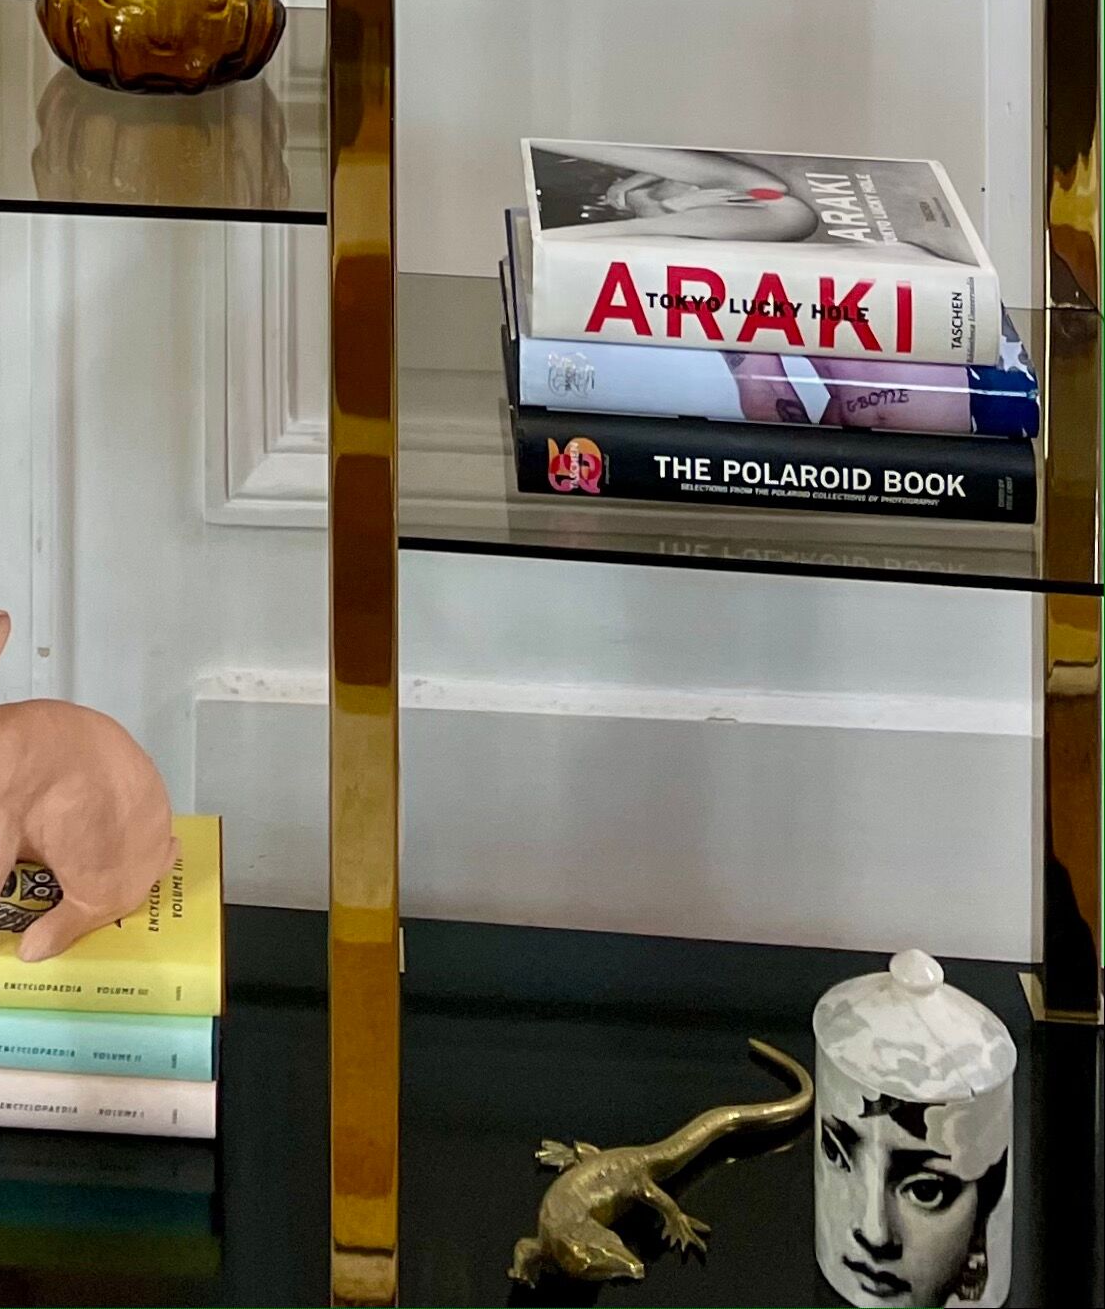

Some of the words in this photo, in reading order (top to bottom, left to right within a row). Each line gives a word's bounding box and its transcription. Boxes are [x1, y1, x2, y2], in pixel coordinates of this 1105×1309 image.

[855, 173, 877, 194] HOLE
[805, 172, 877, 244] ARAKI
[864, 193, 888, 220] LUCKY
[584, 261, 913, 353] ARAKI
[645, 292, 721, 313] TOKYO
[729, 298, 803, 319] LUCKY
[811, 303, 870, 323] HOLE
[951, 291, 963, 349] TASCHEN
[653, 455, 711, 481] THE
[723, 459, 872, 491] POLAROID
[883, 469, 966, 497] BOOK
[680, 483, 728, 493] SELECTIONS
[729, 486, 753, 494] FROM
[755, 487, 769, 496] THE
[771, 488, 810, 498] POLAROID
[812, 491, 866, 502] COLLECTIONS
[881, 496, 940, 506] PHOTOGRAPHY
[148, 880, 161, 931] ENCYCLO
[172, 875, 183, 918] VOLUME
[4, 982, 82, 993] ENCYCLOPAEDIA
[97, 986, 135, 995] VOLUME
[93, 1051, 131, 1062] VOLUME
[0, 1102, 78, 1114] ENCYCLOPAEDIA
[98, 1108, 137, 1118] VOLUME
